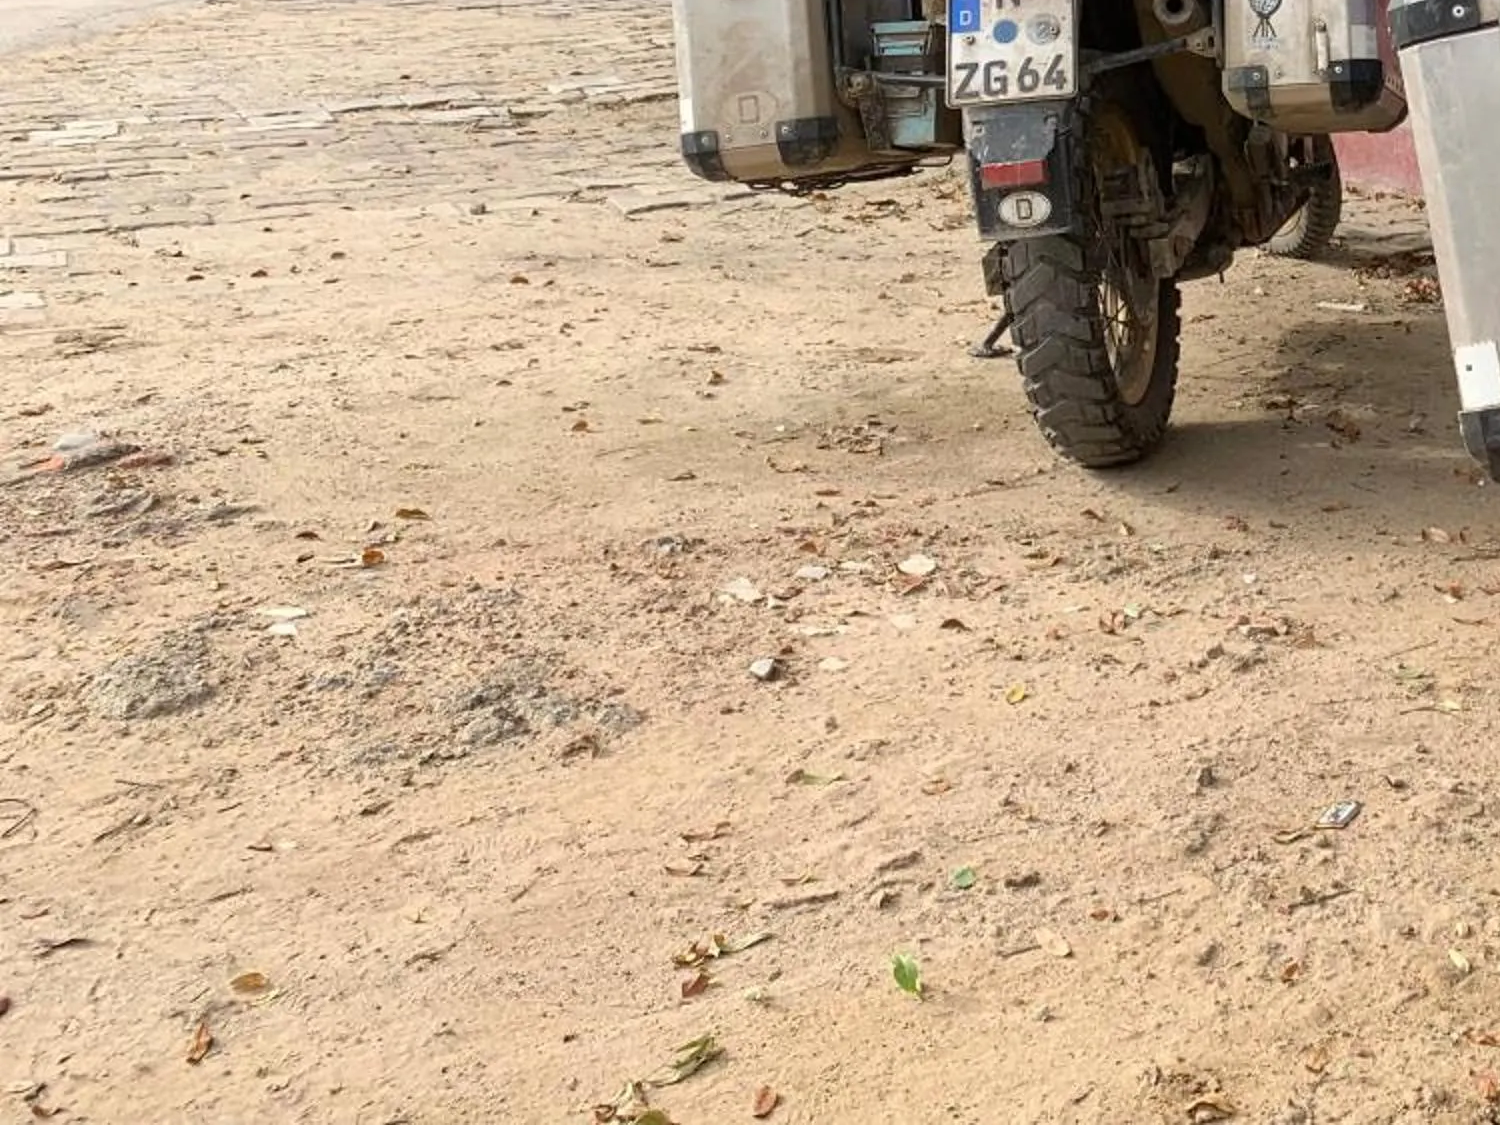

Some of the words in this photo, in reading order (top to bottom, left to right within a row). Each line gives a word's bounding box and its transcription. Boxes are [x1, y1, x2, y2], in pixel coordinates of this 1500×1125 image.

[959, 10, 972, 25] D
[954, 60, 1008, 100] ZG
[1017, 54, 1068, 93] 64
[1015, 198, 1033, 220] D
